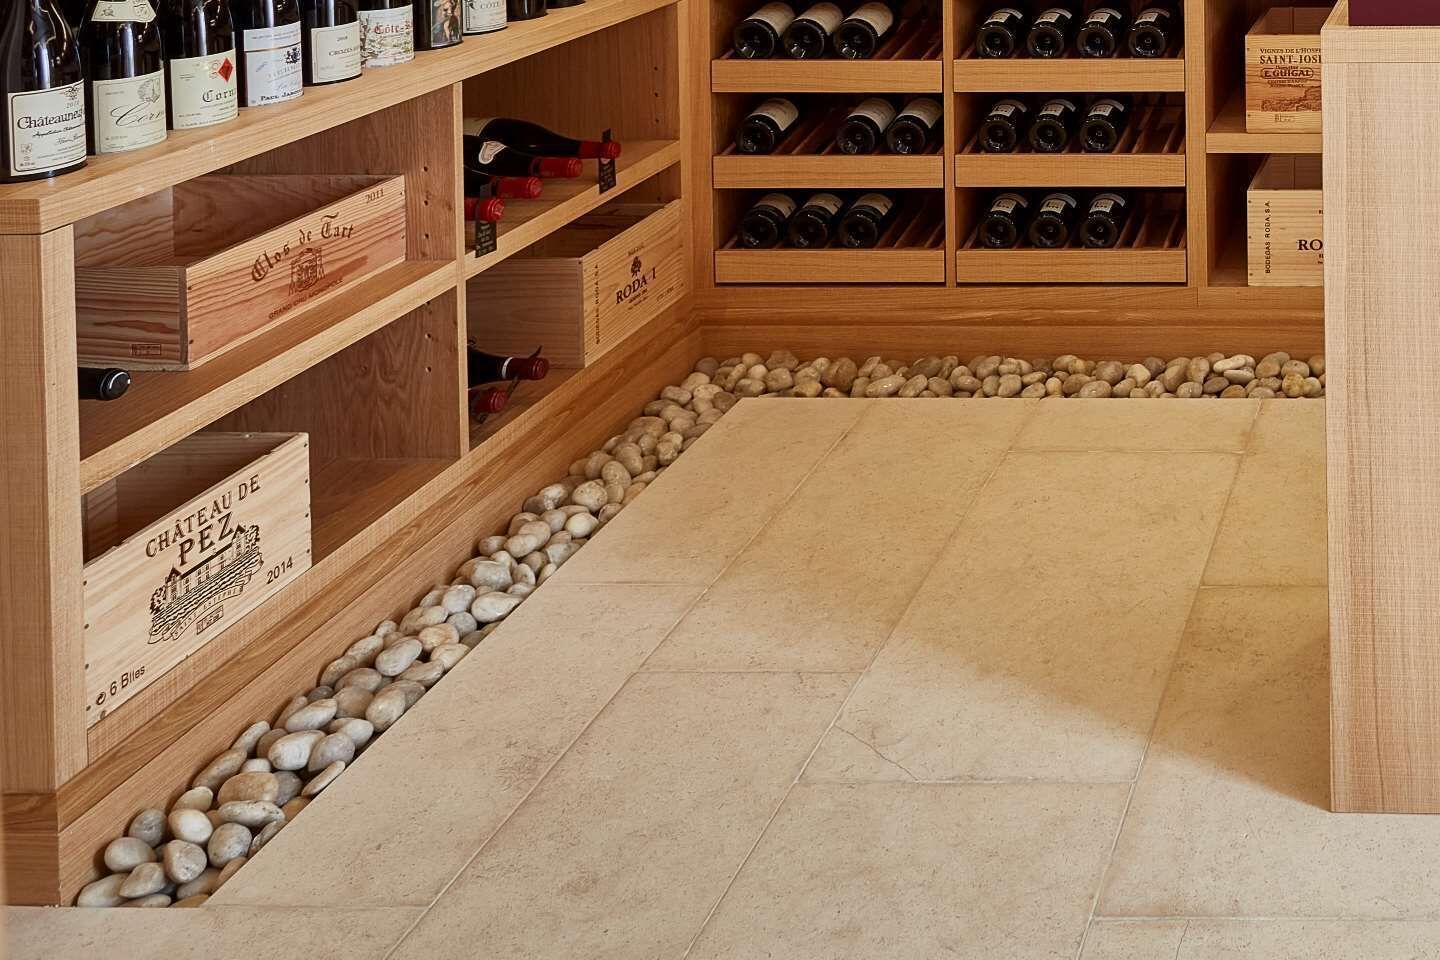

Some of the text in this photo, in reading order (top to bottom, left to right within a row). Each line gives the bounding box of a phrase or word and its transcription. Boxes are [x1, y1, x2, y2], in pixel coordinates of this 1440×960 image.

[251, 211, 355, 282] Clos de Tart
[615, 274, 649, 305] RODA
[145, 473, 262, 558] CHÂTEAU DE
[178, 510, 235, 567] PEZ
[266, 555, 294, 585] 2014
[109, 681, 118, 696] 6
